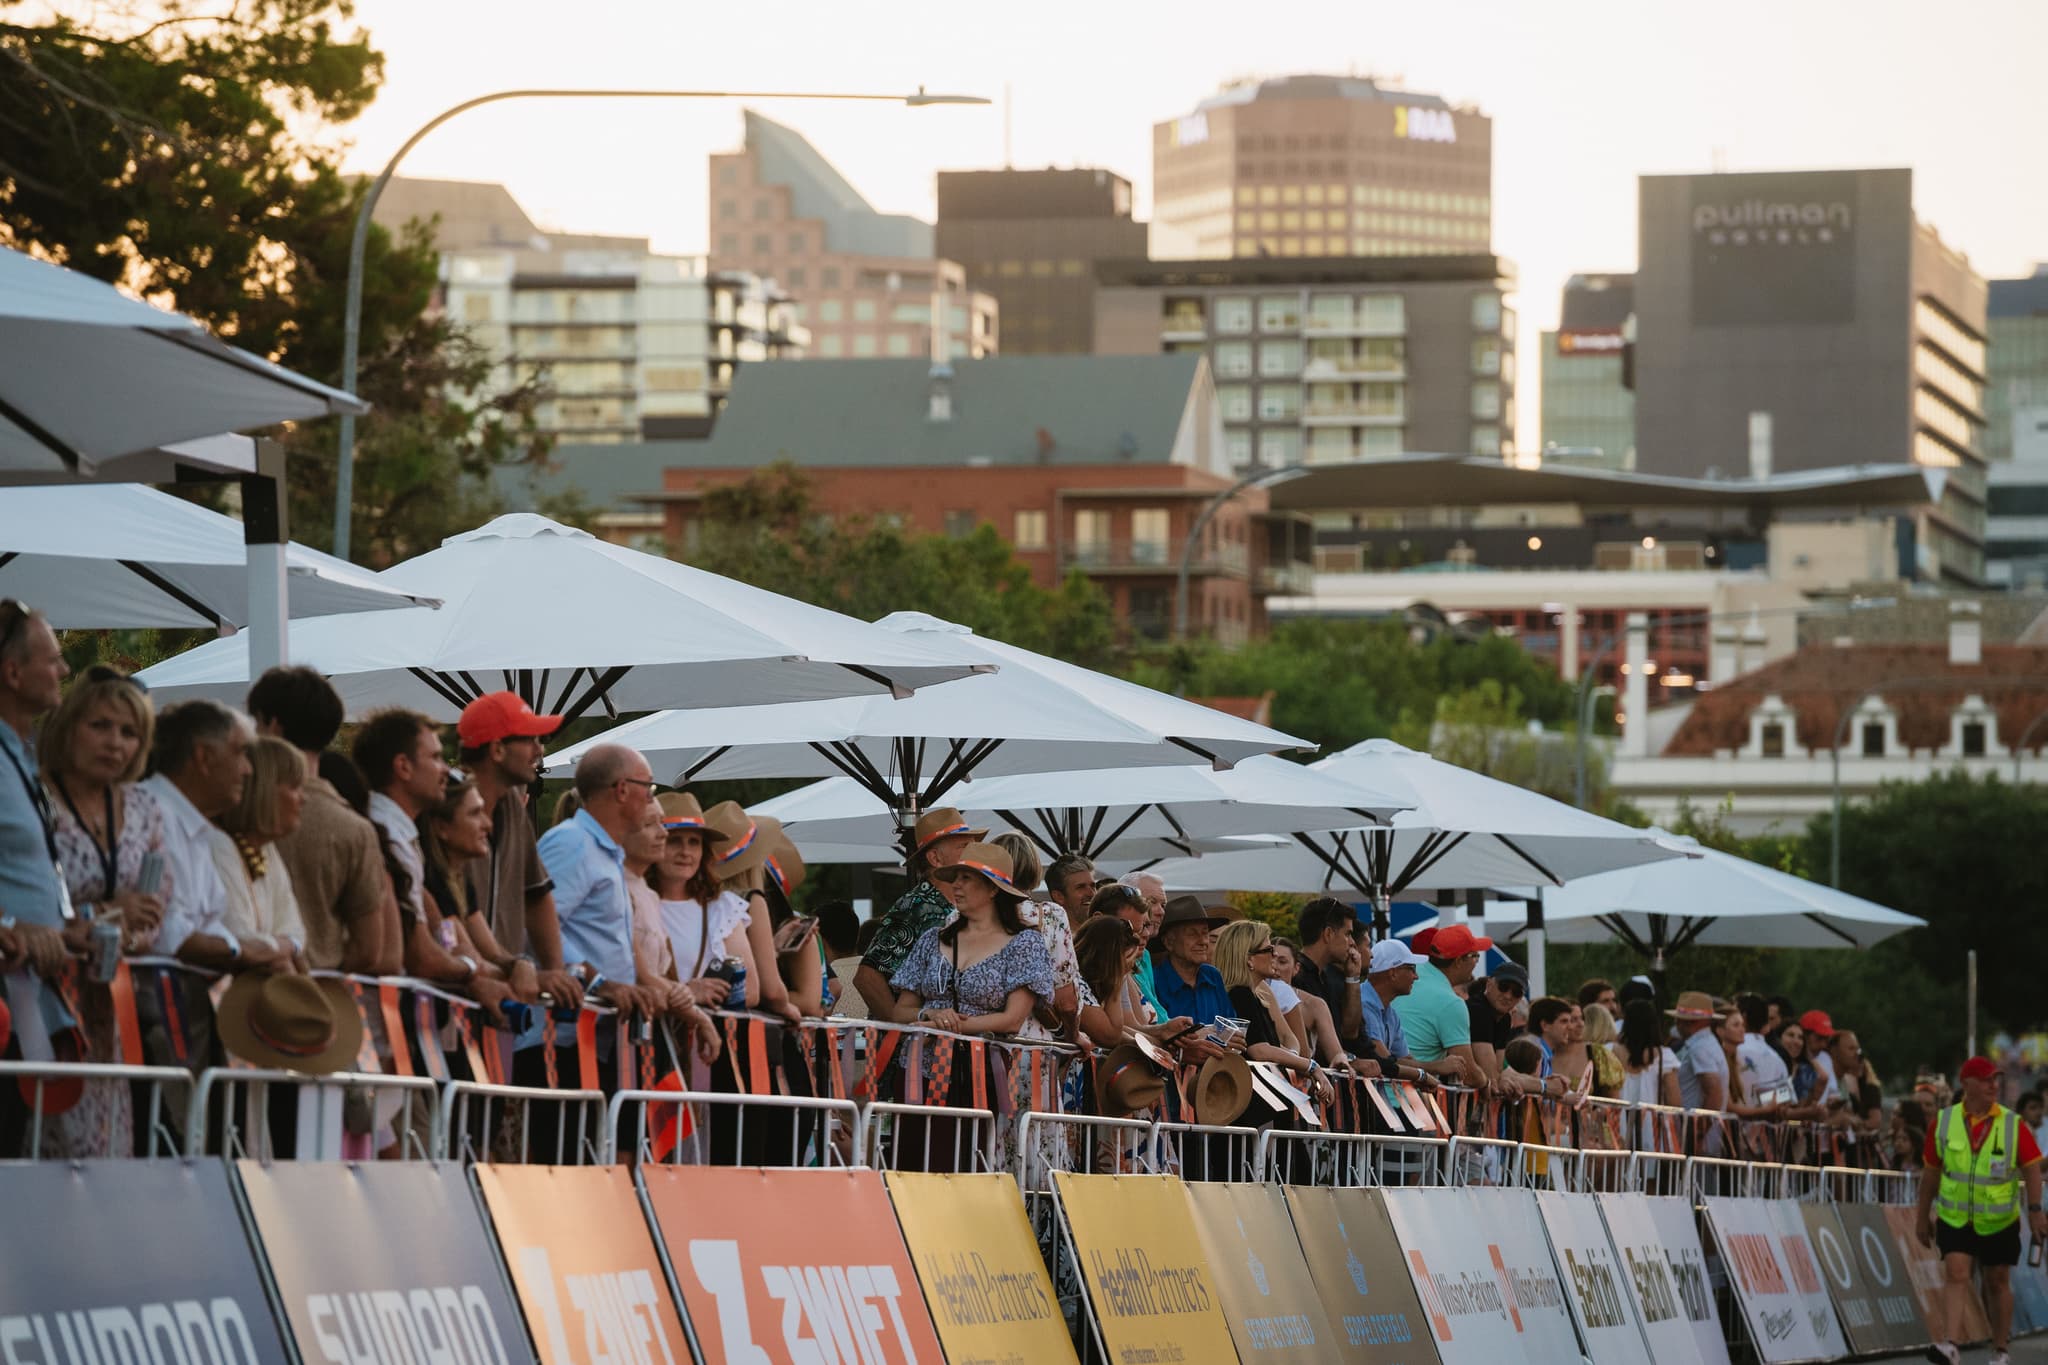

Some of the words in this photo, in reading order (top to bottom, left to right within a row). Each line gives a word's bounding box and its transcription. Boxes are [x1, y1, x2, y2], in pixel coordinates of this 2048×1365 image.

[1693, 200, 1850, 231] pullman
[760, 1265, 918, 1365] ZWIFT
[1460, 1270, 1507, 1321] Parking
[1565, 1248, 1626, 1328] Santini
